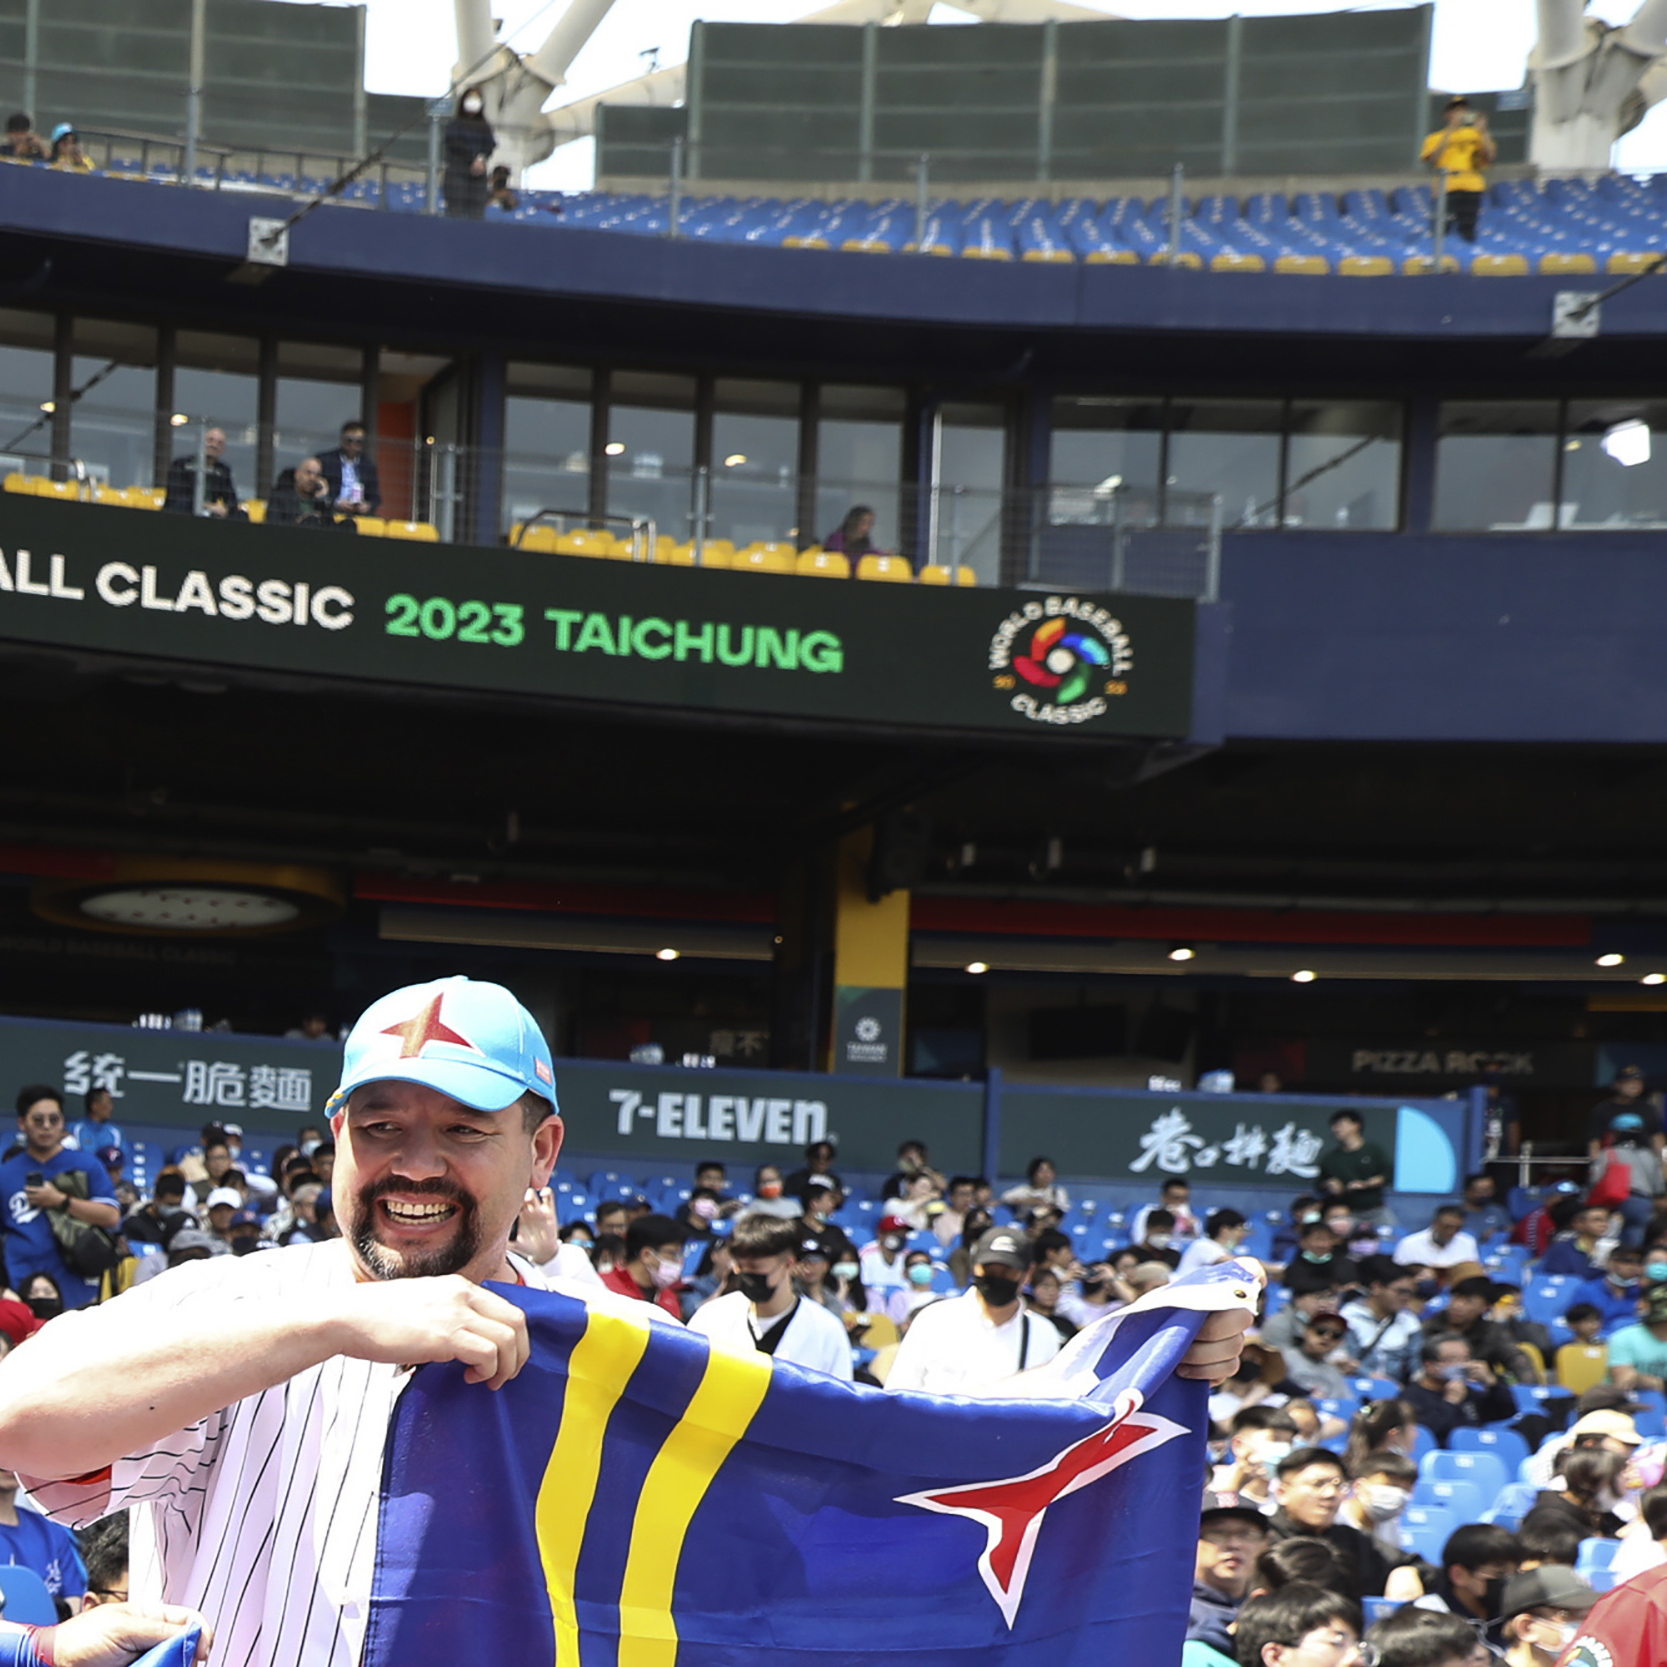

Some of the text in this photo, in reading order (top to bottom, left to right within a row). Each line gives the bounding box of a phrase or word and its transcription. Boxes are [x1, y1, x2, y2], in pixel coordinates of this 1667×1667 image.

[95, 561, 355, 630] CLASSIC
[385, 594, 525, 646] 2023
[545, 609, 843, 673] TAICHUNG
[988, 596, 1134, 676] WORLD BASEBALL
[1010, 693, 1107, 725] CLASSIC
[63, 1050, 313, 1112] 統一脆麵
[1351, 1049, 1441, 1073] PIZZA
